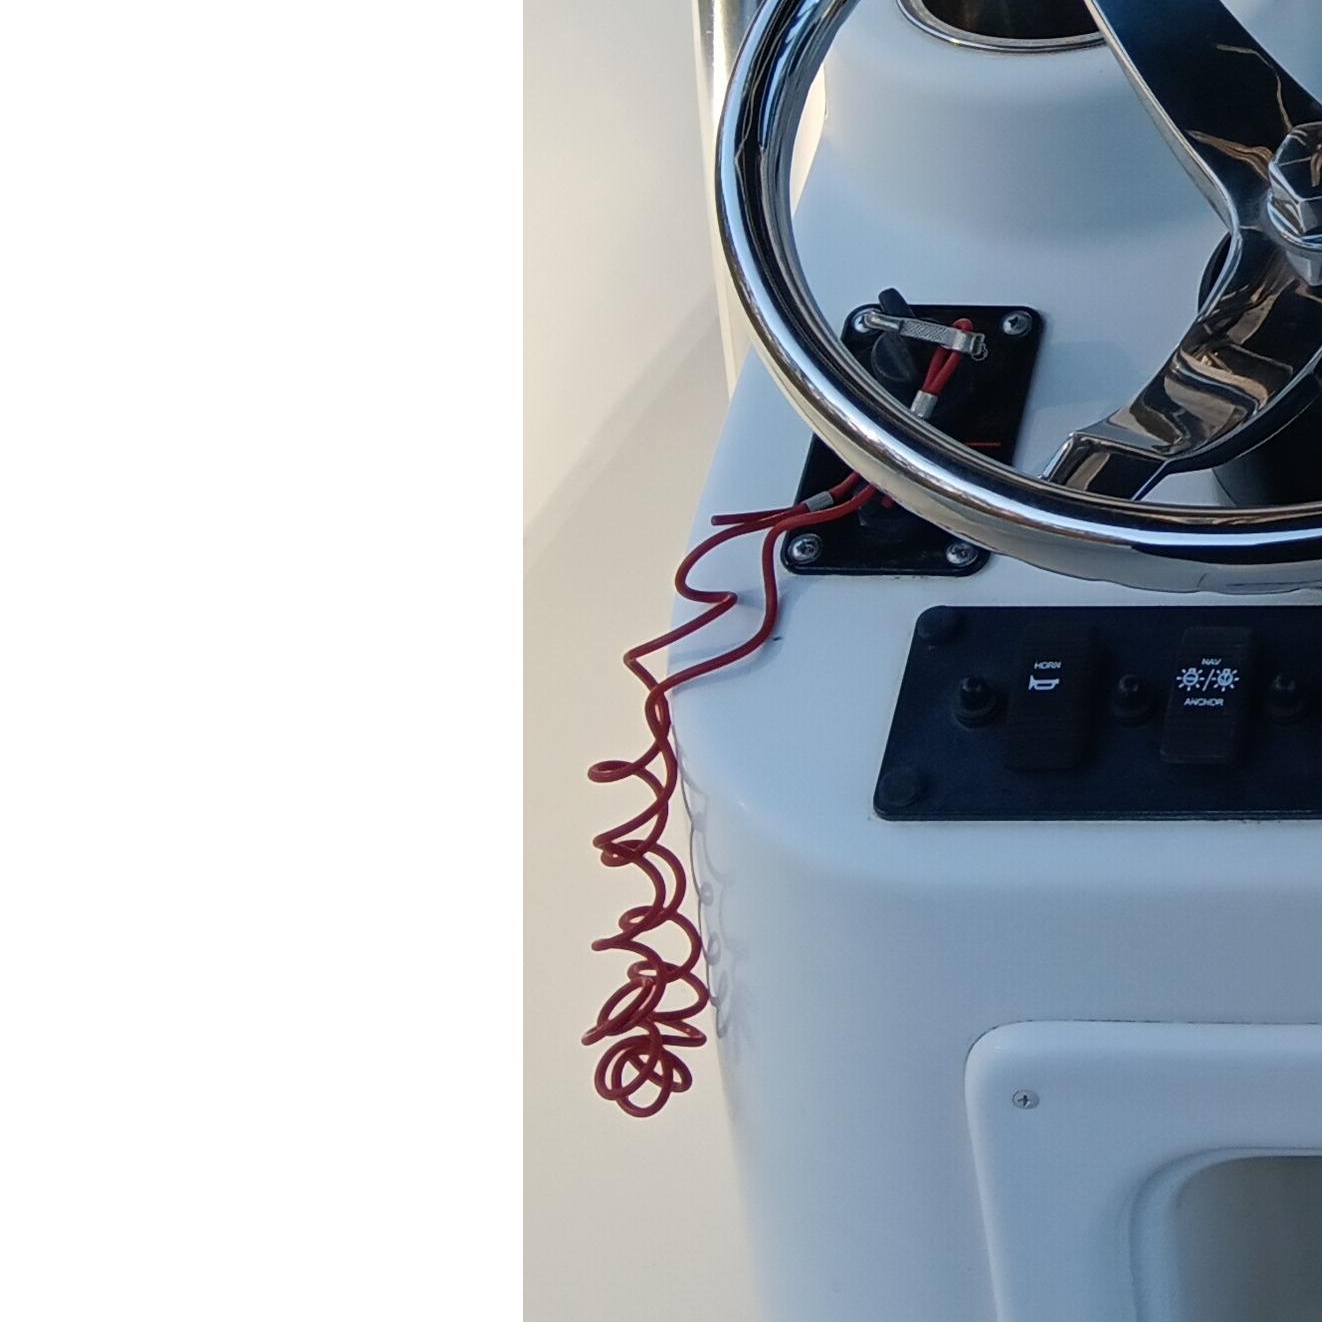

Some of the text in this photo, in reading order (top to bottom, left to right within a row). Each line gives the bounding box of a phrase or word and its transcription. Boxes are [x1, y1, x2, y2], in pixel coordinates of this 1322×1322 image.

[1034, 661, 1062, 670] HORN
[1201, 658, 1222, 666] NAV
[1183, 697, 1225, 707] ANCHOR
